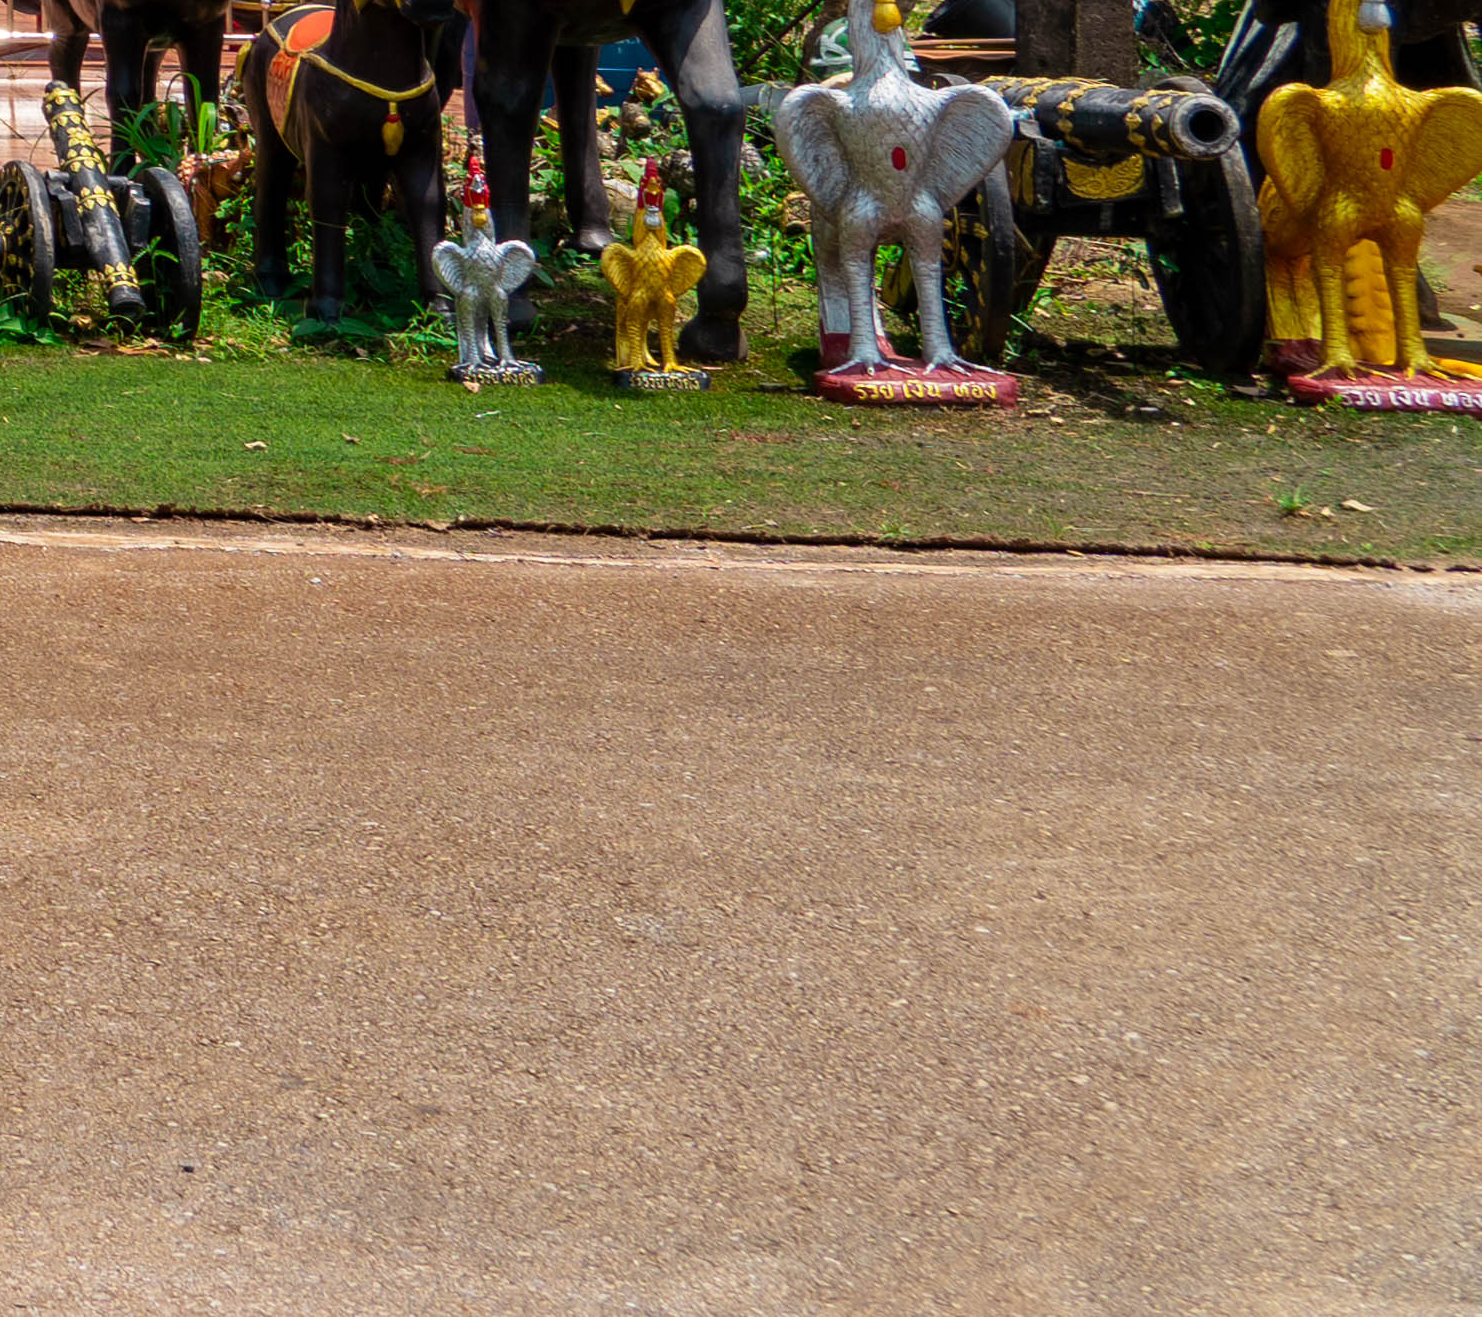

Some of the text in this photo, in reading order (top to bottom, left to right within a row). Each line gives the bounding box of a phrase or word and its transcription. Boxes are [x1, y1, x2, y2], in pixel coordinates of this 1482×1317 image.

[854, 379, 998, 400] รวย เงิน ทอง
[1388, 385, 1431, 407] เงิน
